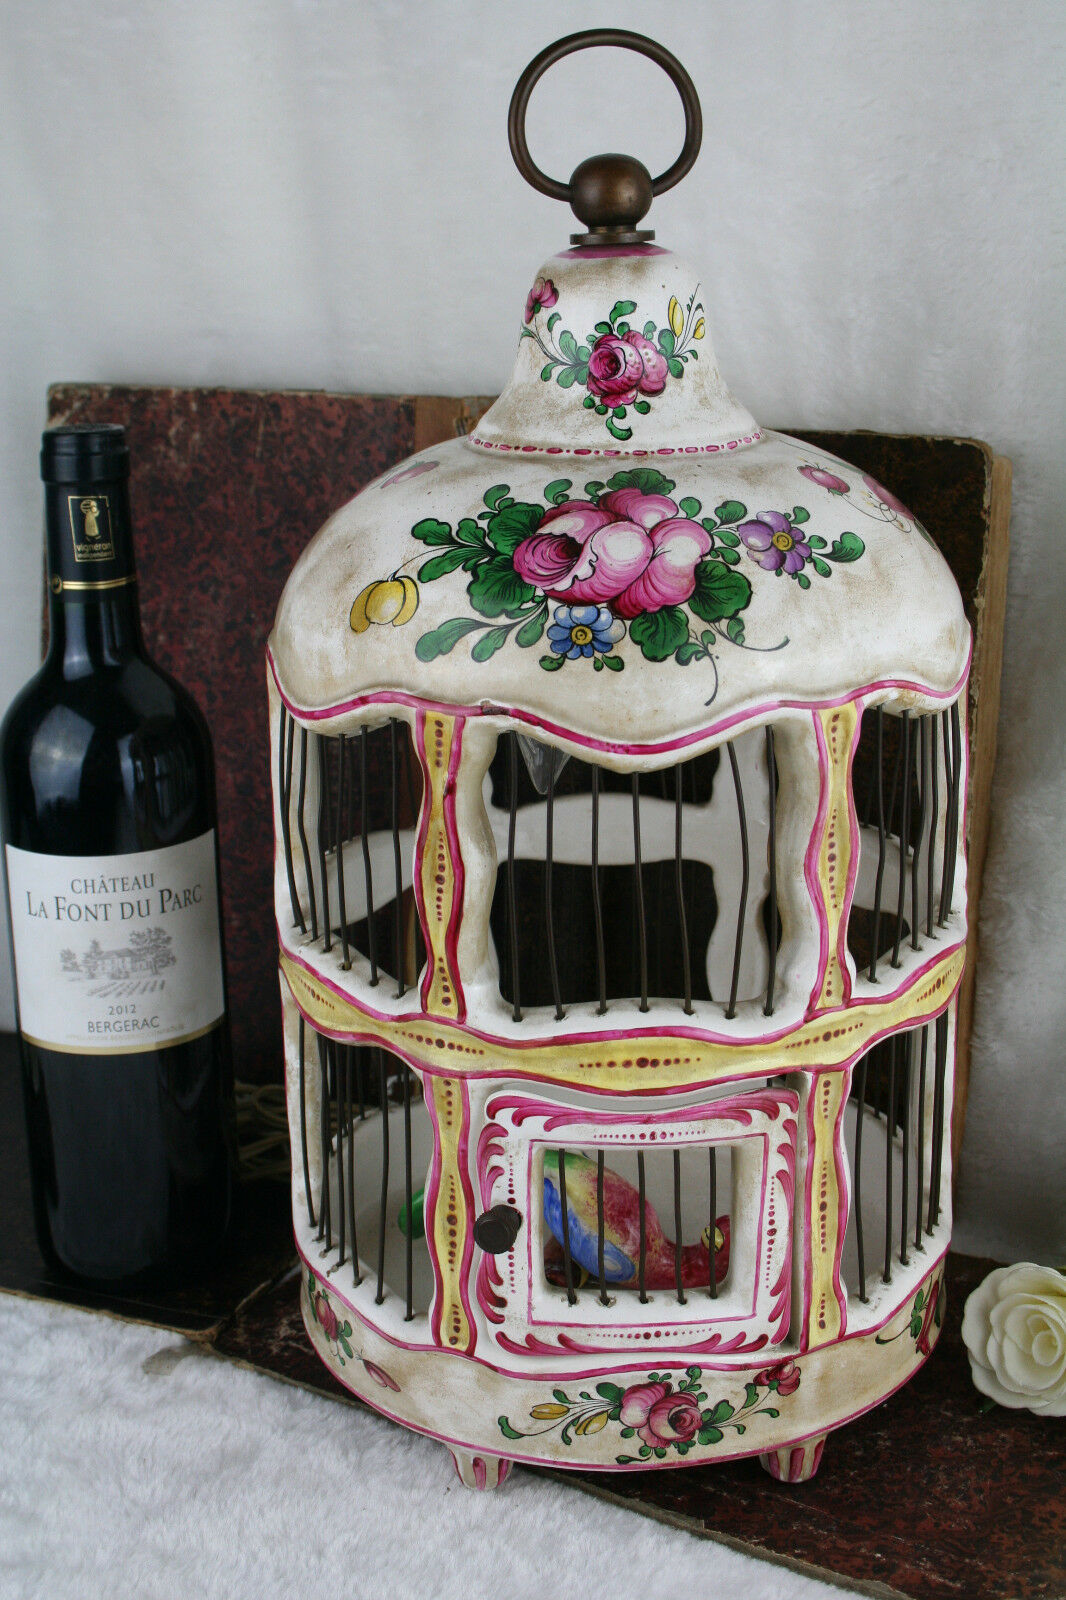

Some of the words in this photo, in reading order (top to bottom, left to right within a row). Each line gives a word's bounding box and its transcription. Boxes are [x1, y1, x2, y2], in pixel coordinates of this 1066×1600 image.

[70, 873, 155, 894] CHÂTEAU
[26, 891, 48, 919] LA
[54, 896, 112, 921] FONT
[119, 899, 150, 920] DU
[159, 884, 202, 914] PARC
[108, 1004, 137, 1016] 2012
[87, 1016, 160, 1033] BERGERAC
